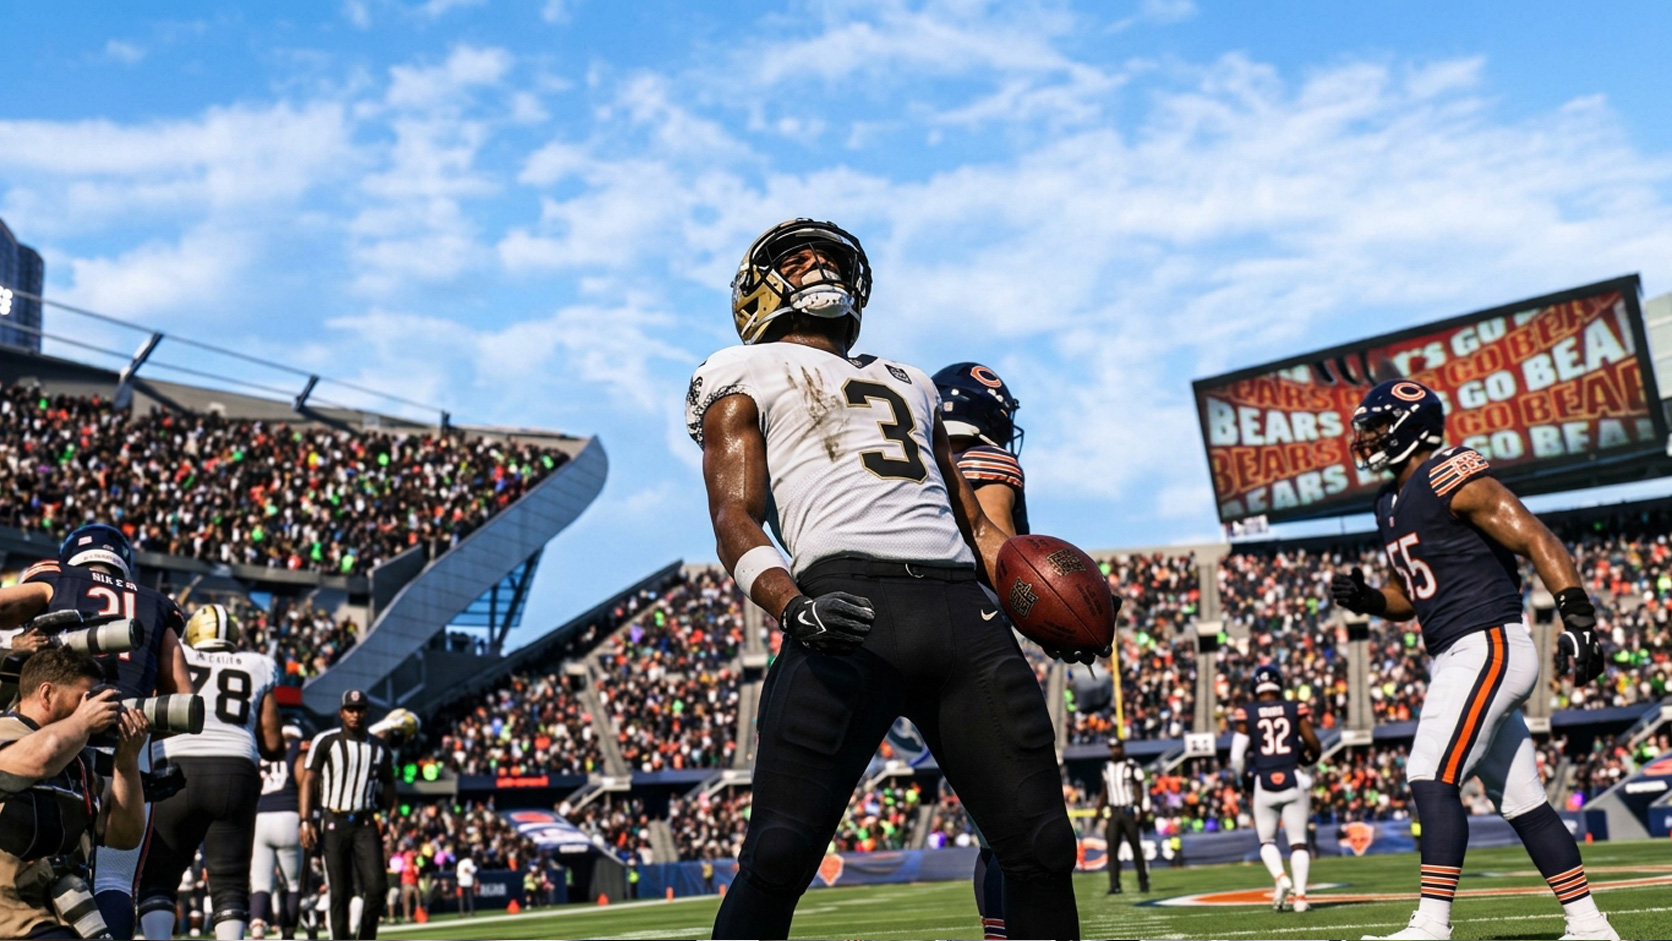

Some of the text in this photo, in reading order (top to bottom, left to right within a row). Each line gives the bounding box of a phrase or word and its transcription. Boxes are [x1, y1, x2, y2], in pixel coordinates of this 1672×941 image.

[1457, 370, 1517, 409] GO
[841, 377, 929, 482] 3
[1206, 397, 1344, 446] BEARS
[1386, 531, 1437, 601] 55
[188, 663, 252, 725] 78
[1257, 717, 1291, 755] 32
